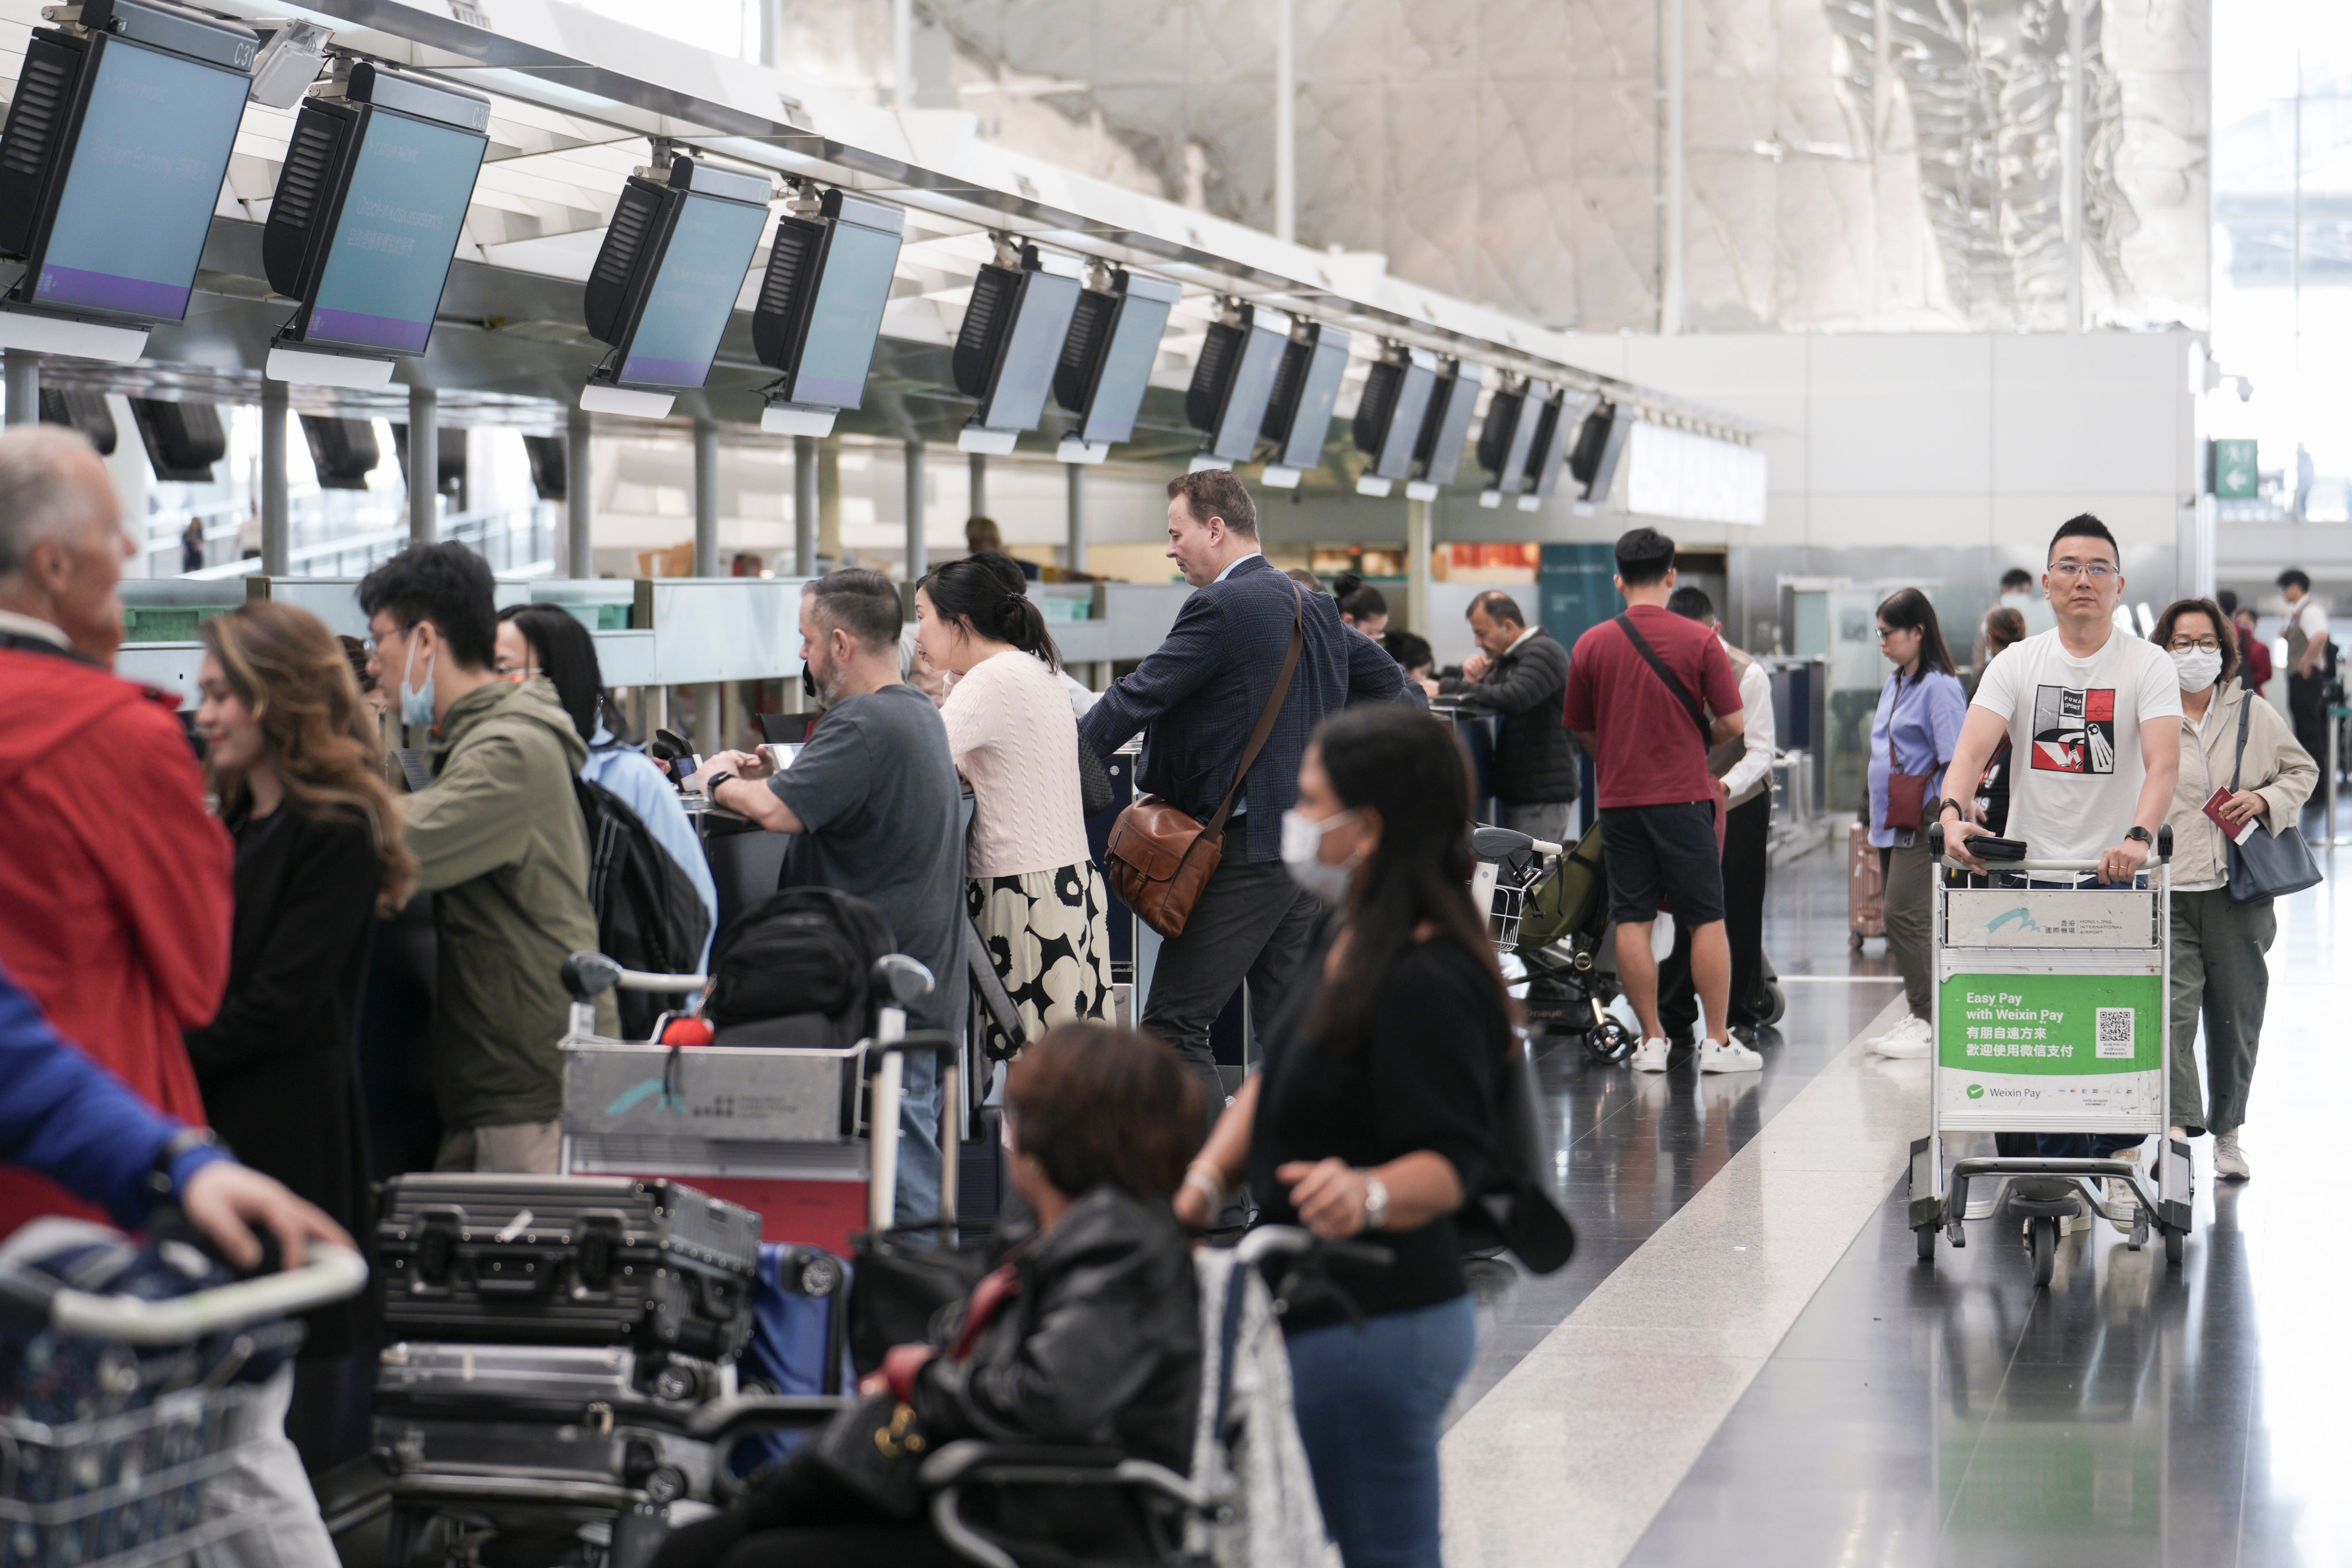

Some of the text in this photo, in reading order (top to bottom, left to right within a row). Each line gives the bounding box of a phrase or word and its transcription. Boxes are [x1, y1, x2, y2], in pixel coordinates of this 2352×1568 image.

[234, 43, 255, 67] C31
[473, 106, 489, 130] C30
[1967, 992, 2022, 1006] Easy Pay
[1967, 1009, 2064, 1023] with Weixin Pay
[1967, 1026, 2046, 1040] 有朋自遠方來
[1967, 1044, 2073, 1057] 歡迎使用微信支付
[1990, 1088, 2041, 1099] Weixin Pay
